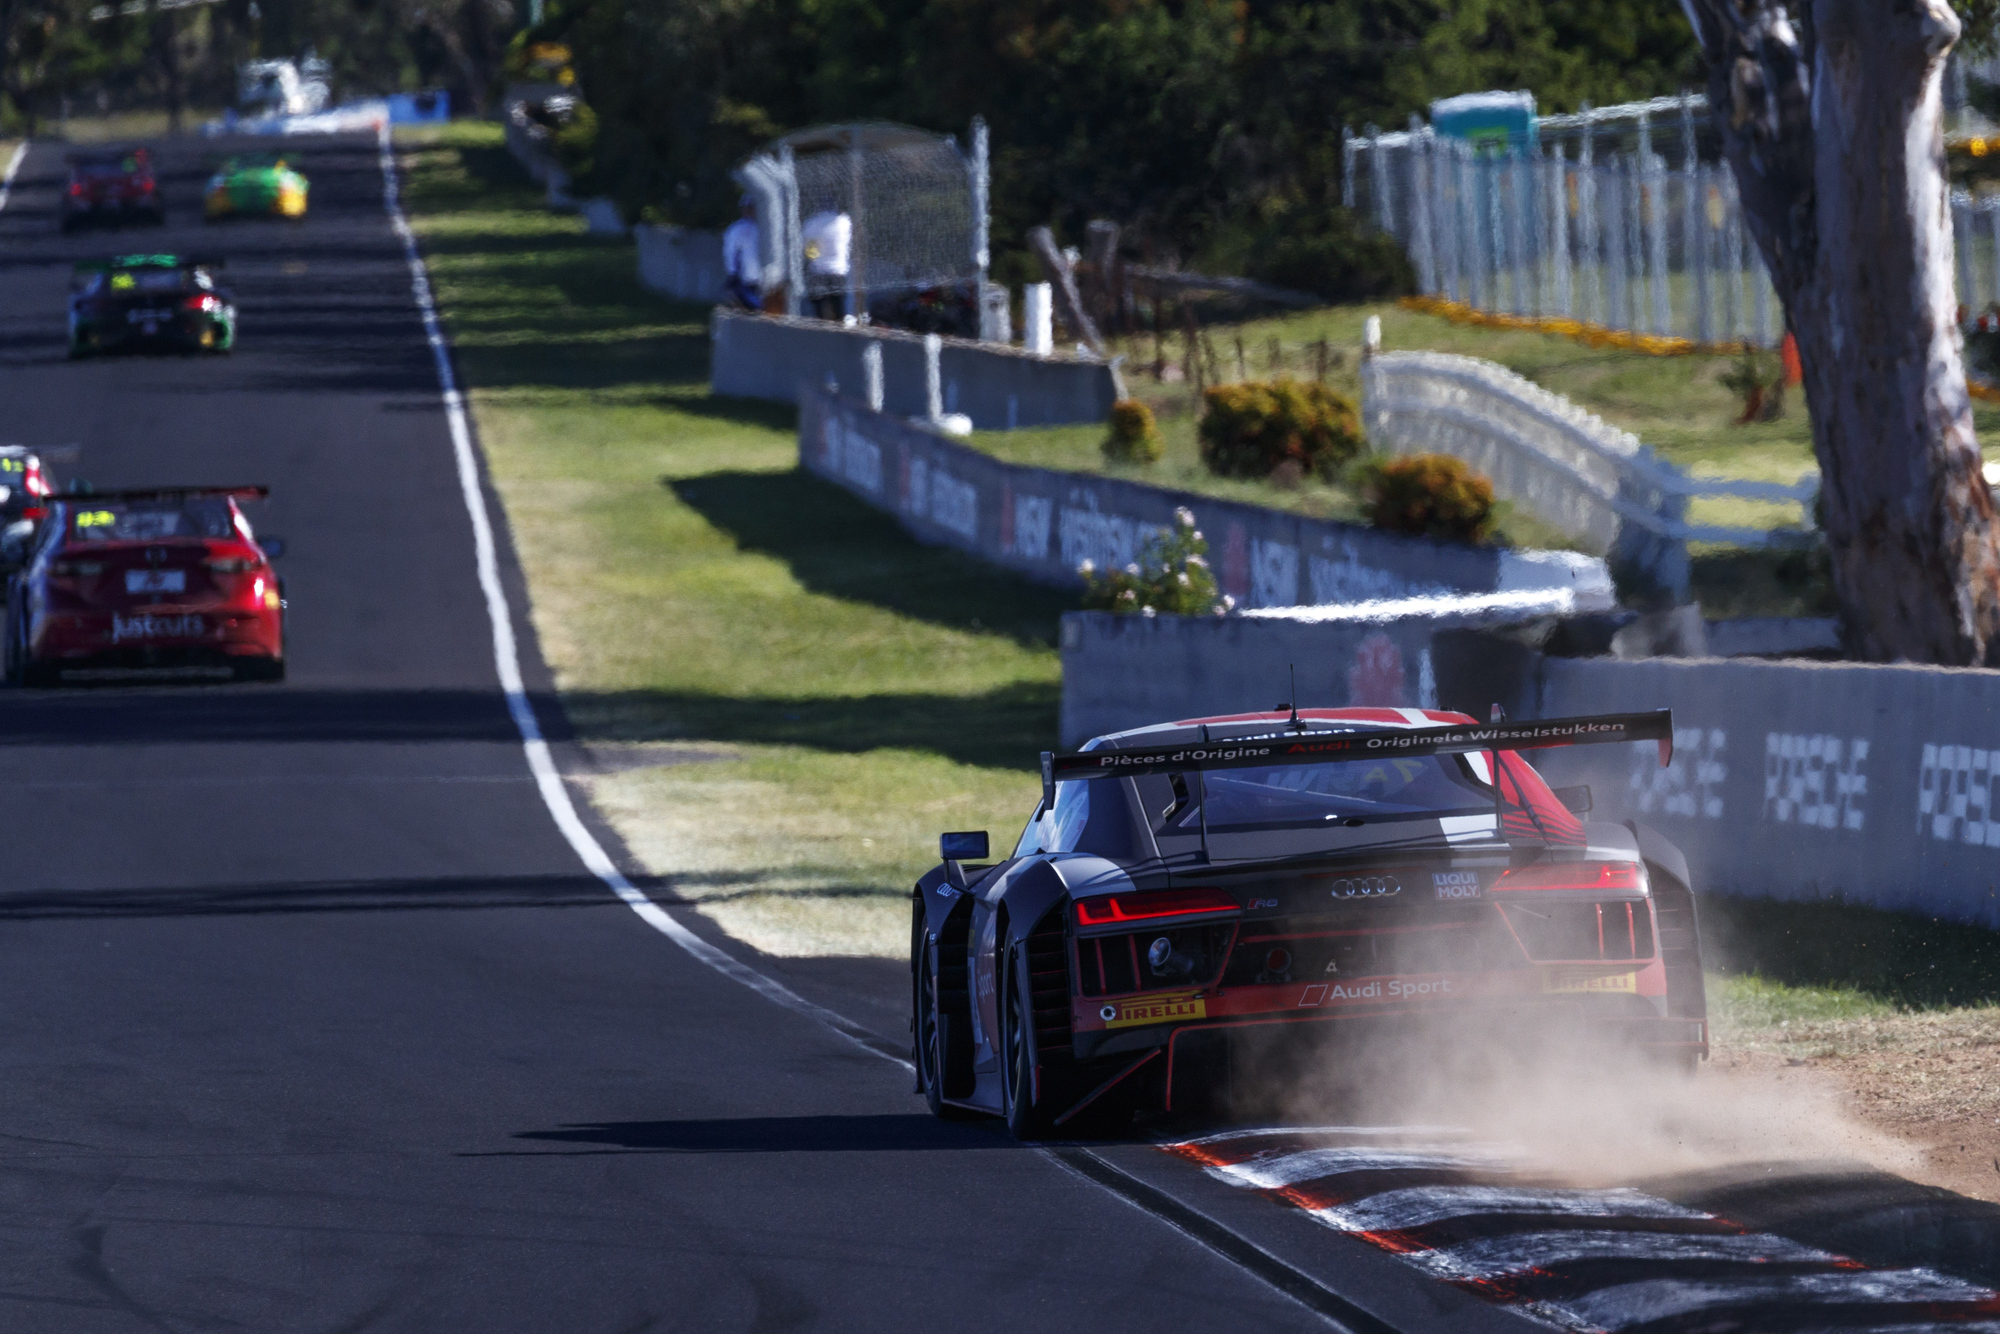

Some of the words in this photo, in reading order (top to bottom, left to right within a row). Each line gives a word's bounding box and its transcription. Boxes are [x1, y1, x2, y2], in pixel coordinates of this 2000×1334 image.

[1100, 753, 1166, 767] Pièces
[1171, 746, 1271, 761] d'Origine
[1287, 739, 1351, 754] Audi
[1366, 733, 1464, 749] Originele
[1469, 722, 1626, 741] Wisselstukken
[1435, 872, 1476, 885] LIQUI
[1437, 885, 1478, 898] MOLY
[1329, 981, 1382, 1000] Audi
[1387, 978, 1452, 1000] Sport
